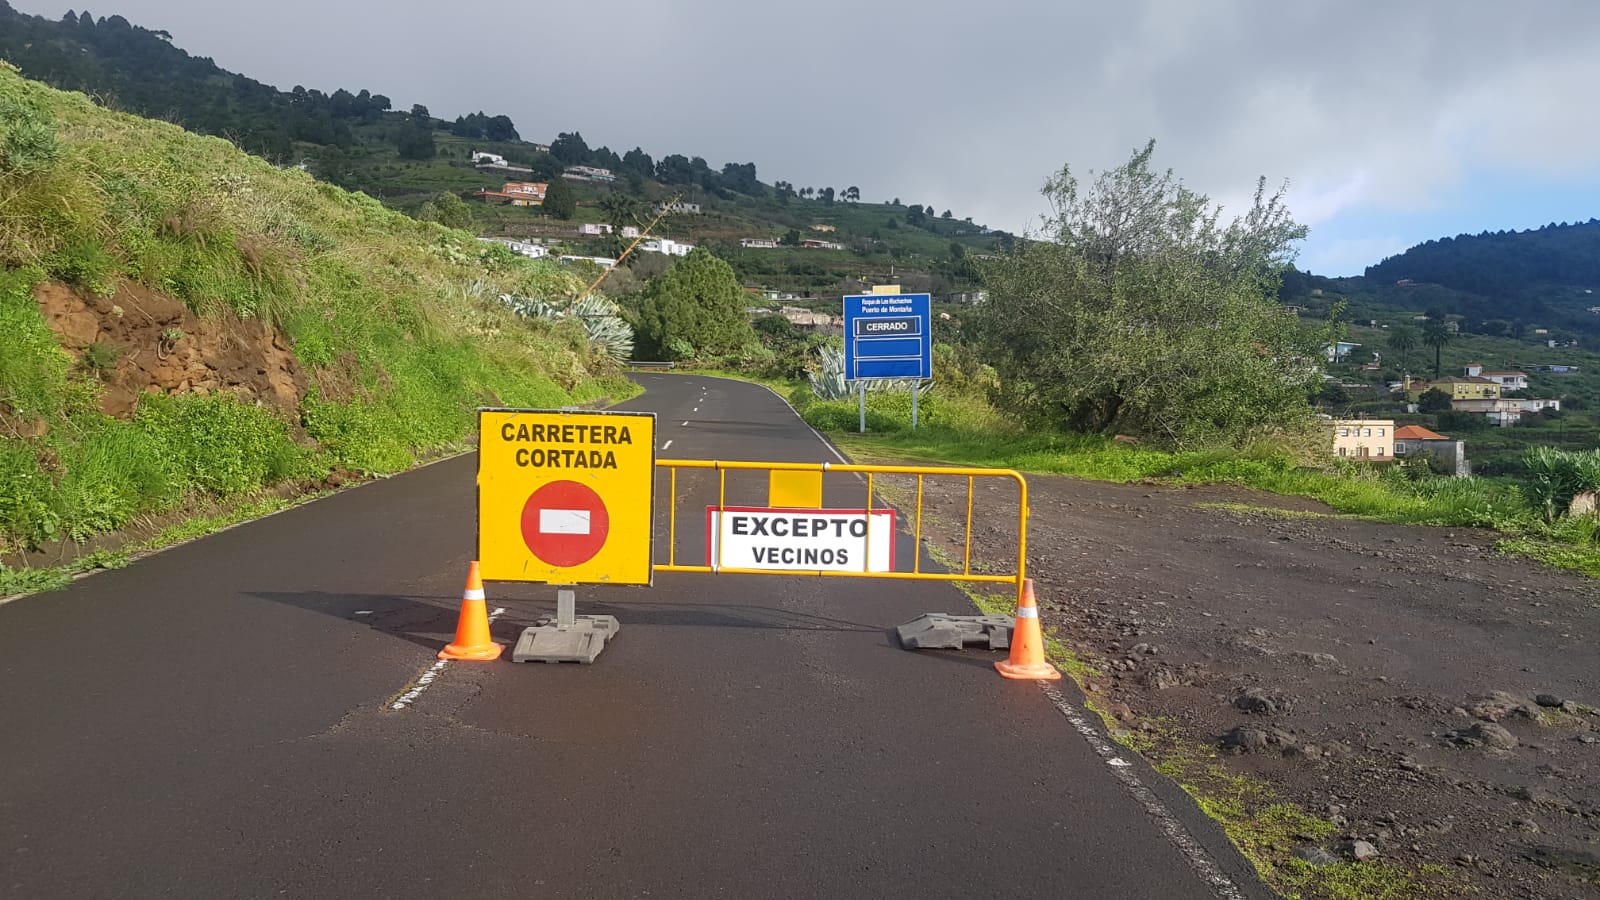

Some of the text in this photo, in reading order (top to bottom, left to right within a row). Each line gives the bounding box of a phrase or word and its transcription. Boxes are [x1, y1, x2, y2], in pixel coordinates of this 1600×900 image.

[889, 305, 912, 313] Montaña
[866, 321, 908, 331] CERRADO
[501, 422, 632, 445] CARRETERA
[515, 448, 618, 469] CORTADA
[732, 516, 868, 538] EXCEPTO
[752, 547, 849, 565] VECINOS
